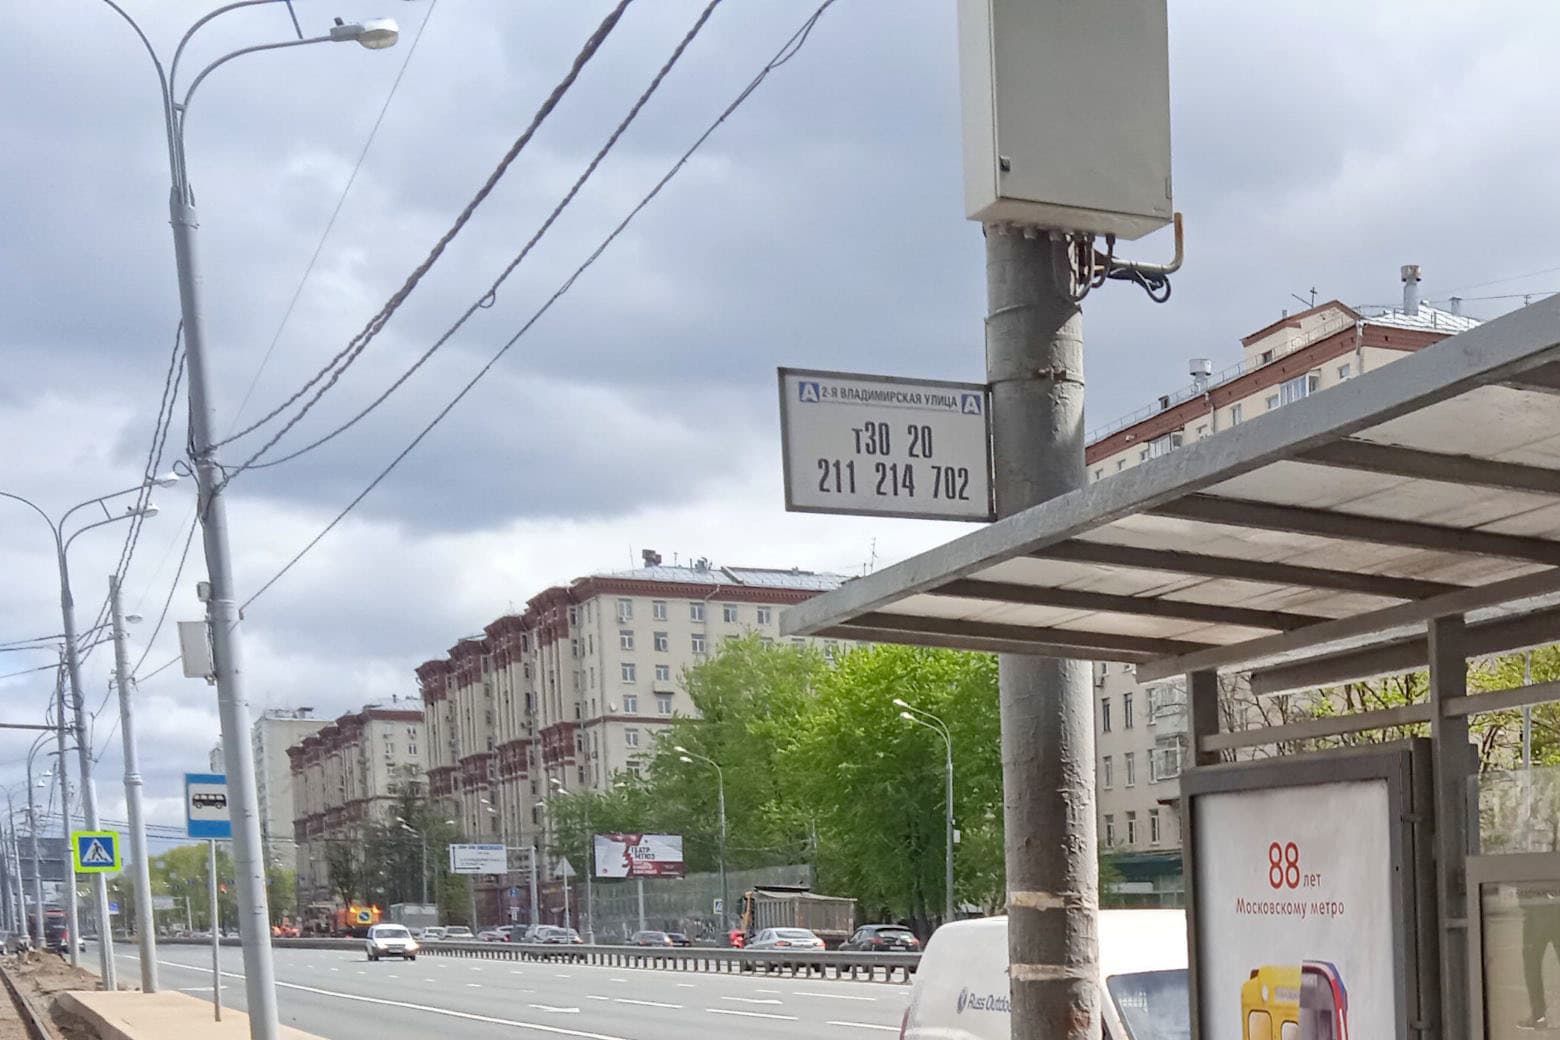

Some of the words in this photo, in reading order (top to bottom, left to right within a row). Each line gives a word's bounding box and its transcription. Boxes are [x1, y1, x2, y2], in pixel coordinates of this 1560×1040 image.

[822, 386, 838, 399] 2-Я
[840, 387, 923, 405] ВЛАДИМИРСКАЯ
[923, 394, 958, 408] УЛИЦА
[907, 424, 932, 458] 20
[818, 459, 856, 493] 211
[875, 462, 915, 497] 214
[931, 466, 970, 500] 702
[1269, 842, 1300, 889] 88
[1303, 873, 1321, 887] лет
[1236, 898, 1307, 919] Московскому
[1311, 900, 1345, 918] метро
[967, 993, 986, 1010] Russ
